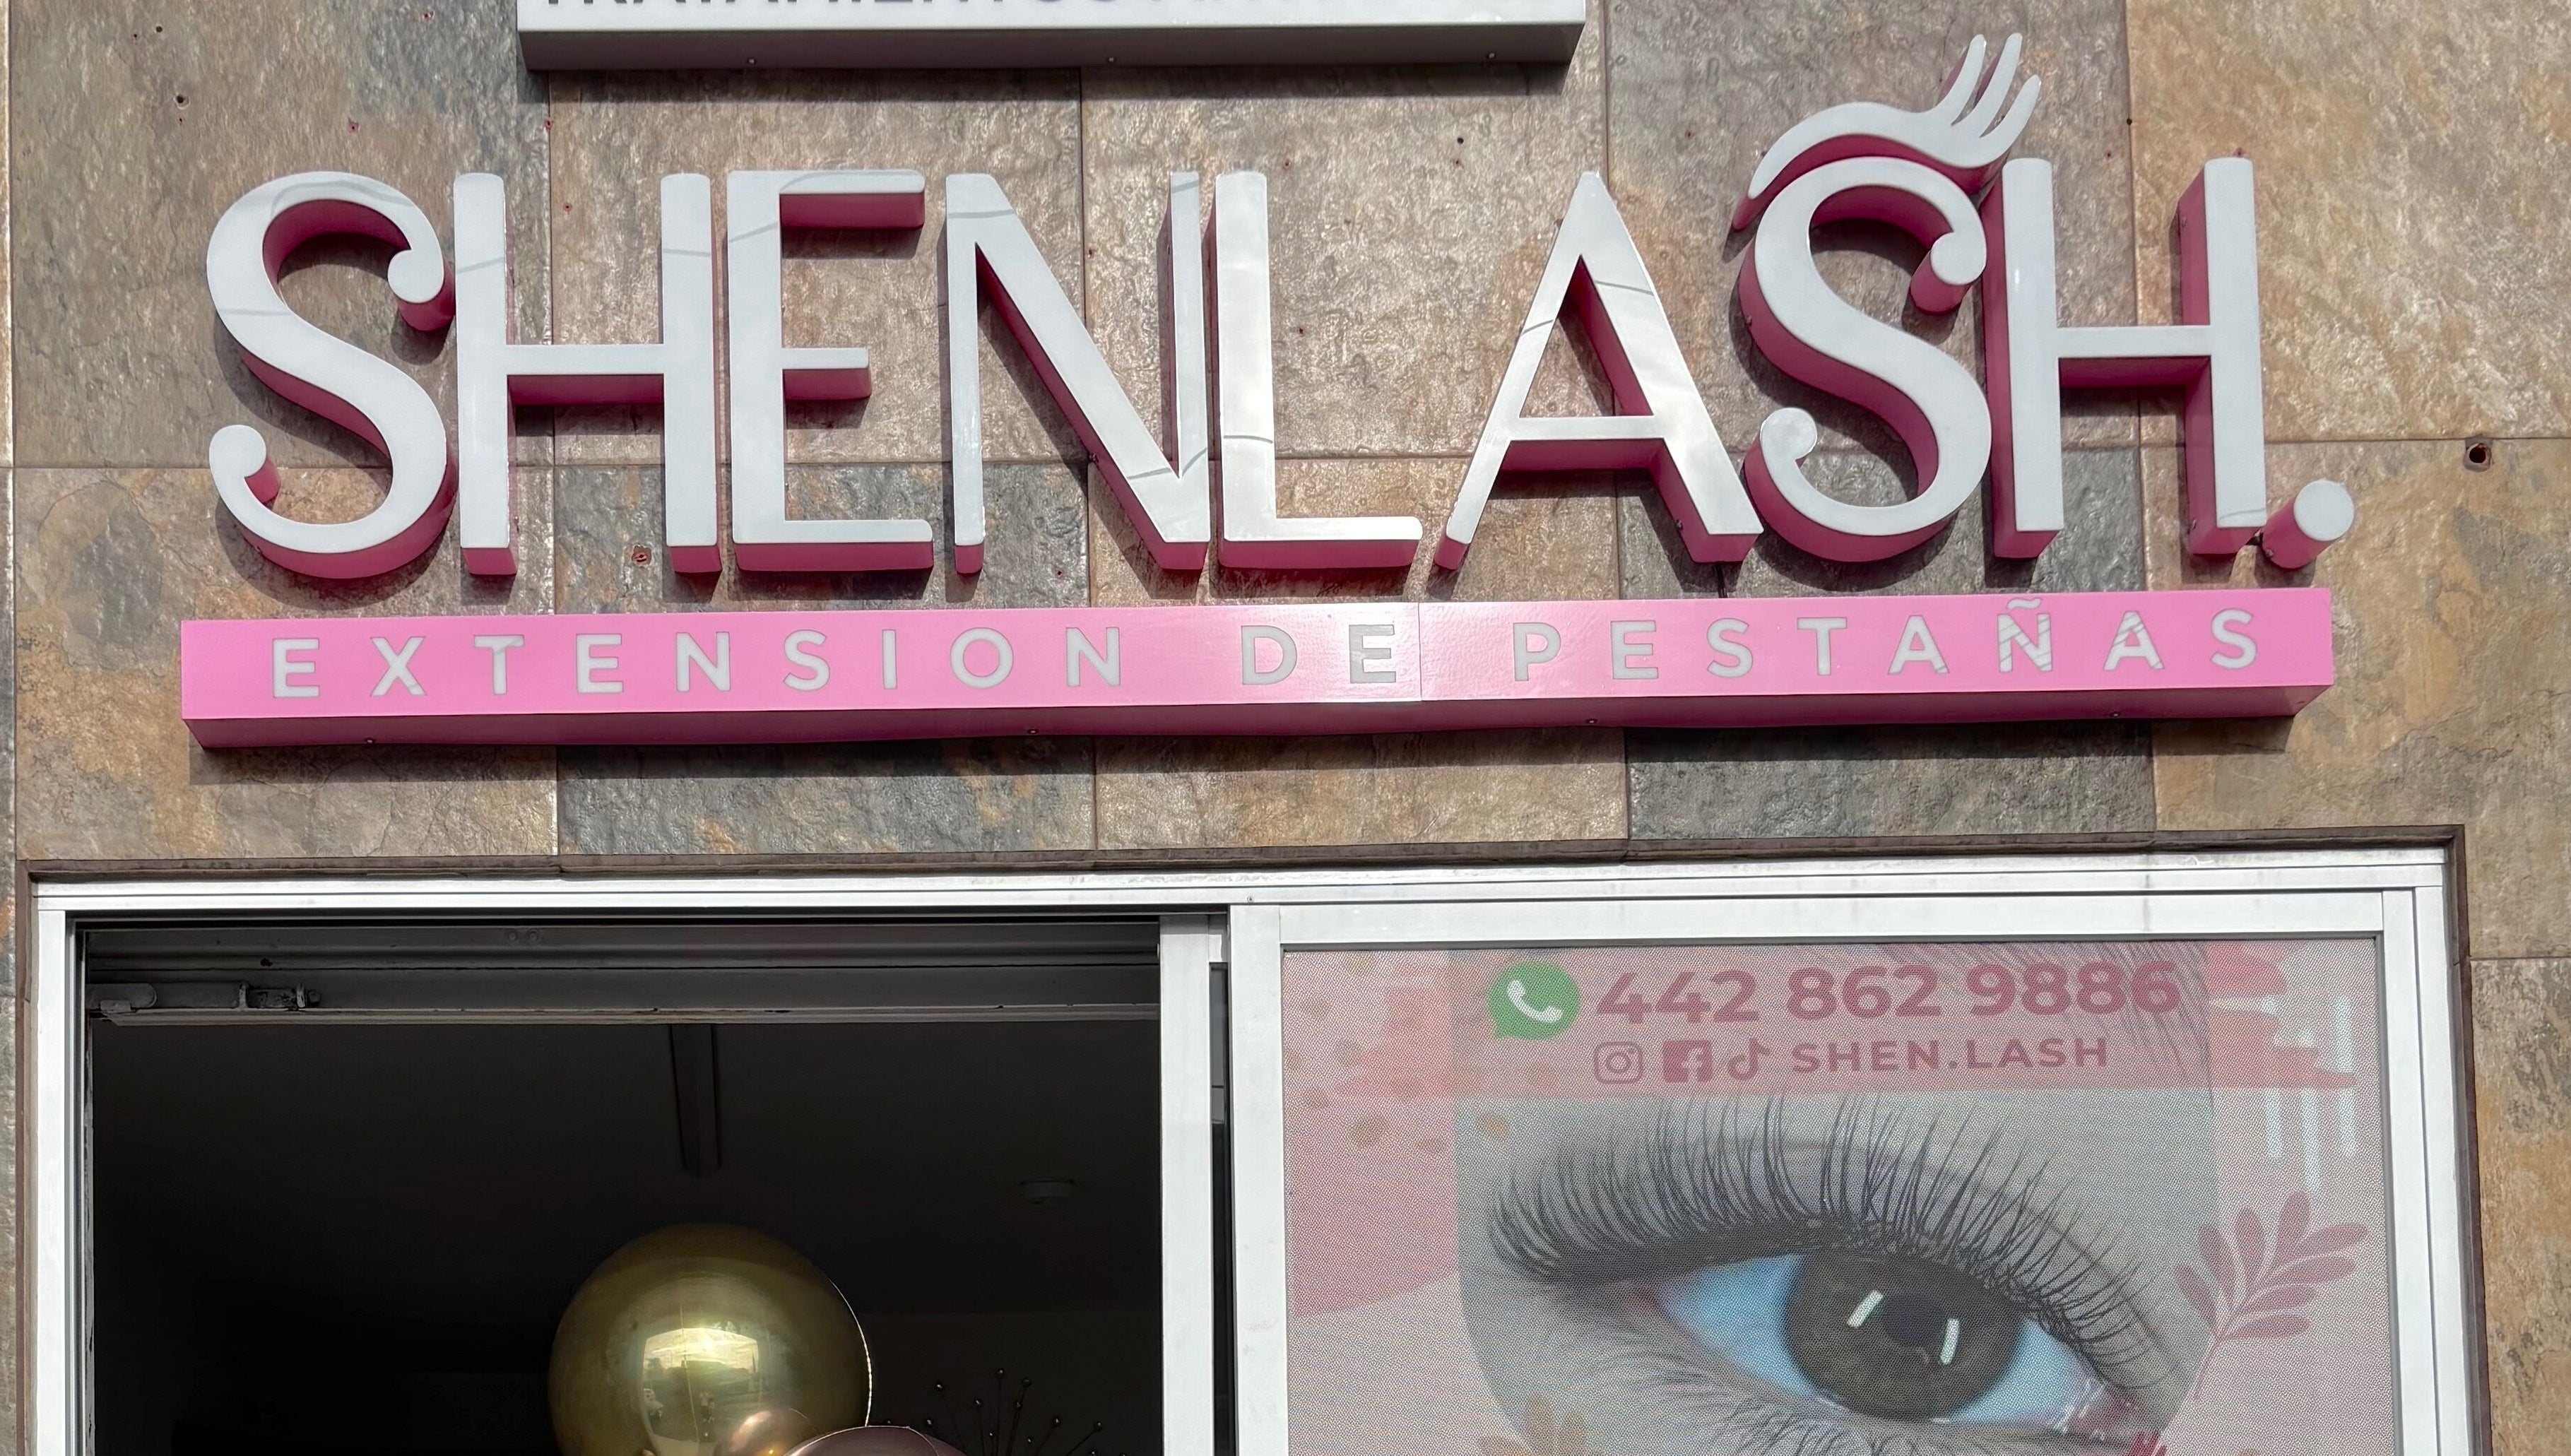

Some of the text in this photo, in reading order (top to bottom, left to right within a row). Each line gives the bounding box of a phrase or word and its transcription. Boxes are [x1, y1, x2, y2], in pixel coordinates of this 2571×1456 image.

[272, 597, 2259, 699] EXTENSION DE PESTAÑAS
[1596, 959, 2182, 1024] 442 862 9886
[1791, 1036, 2108, 1073] SHEN.LASH
